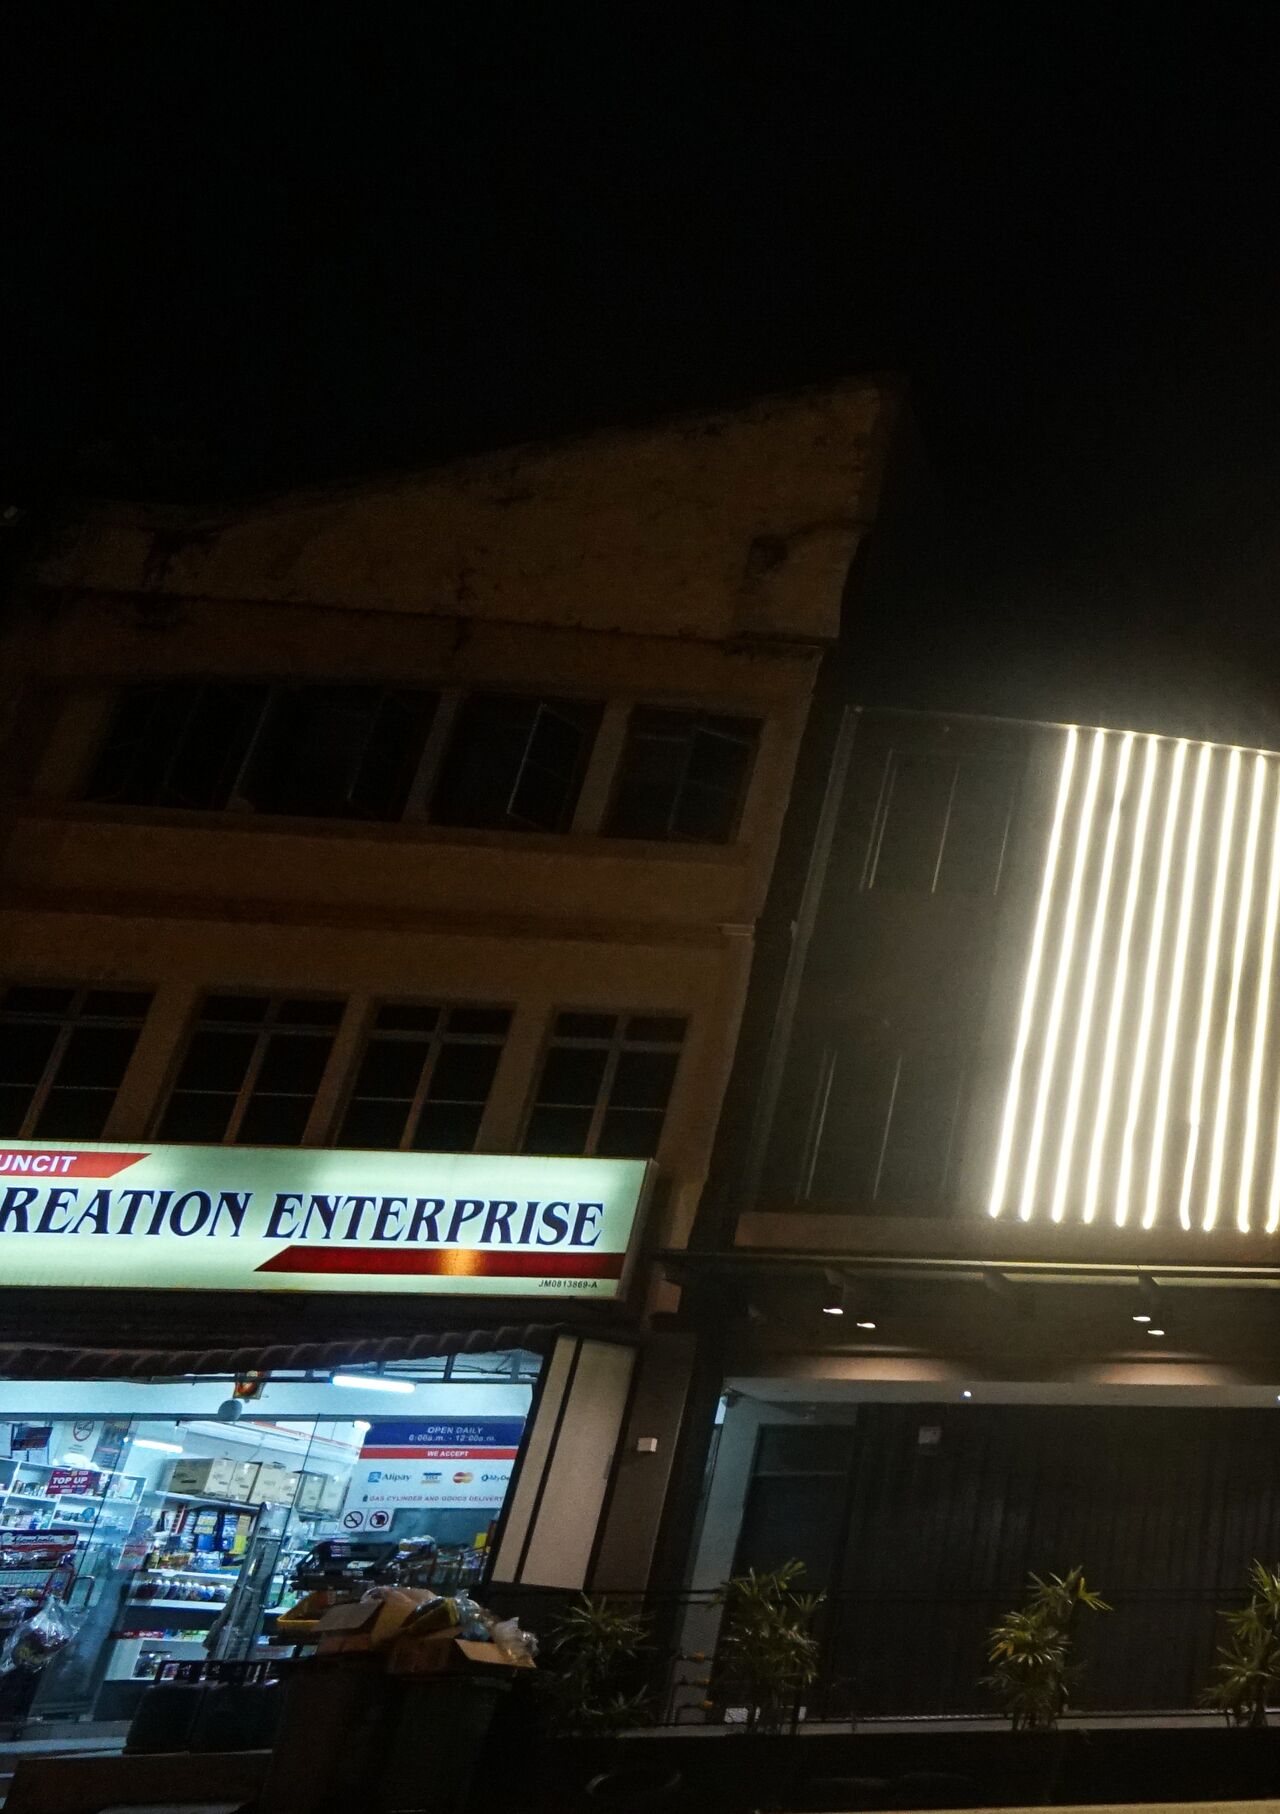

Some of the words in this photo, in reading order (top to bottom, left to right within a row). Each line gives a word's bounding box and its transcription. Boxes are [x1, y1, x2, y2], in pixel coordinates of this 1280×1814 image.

[0, 1186, 254, 1238] REATION
[263, 1193, 605, 1247] ENTERPRISE
[427, 1426, 455, 1434] OPEN
[456, 1426, 484, 1434] DAILY
[53, 1476, 73, 1485] TOP
[74, 1476, 88, 1485] UP
